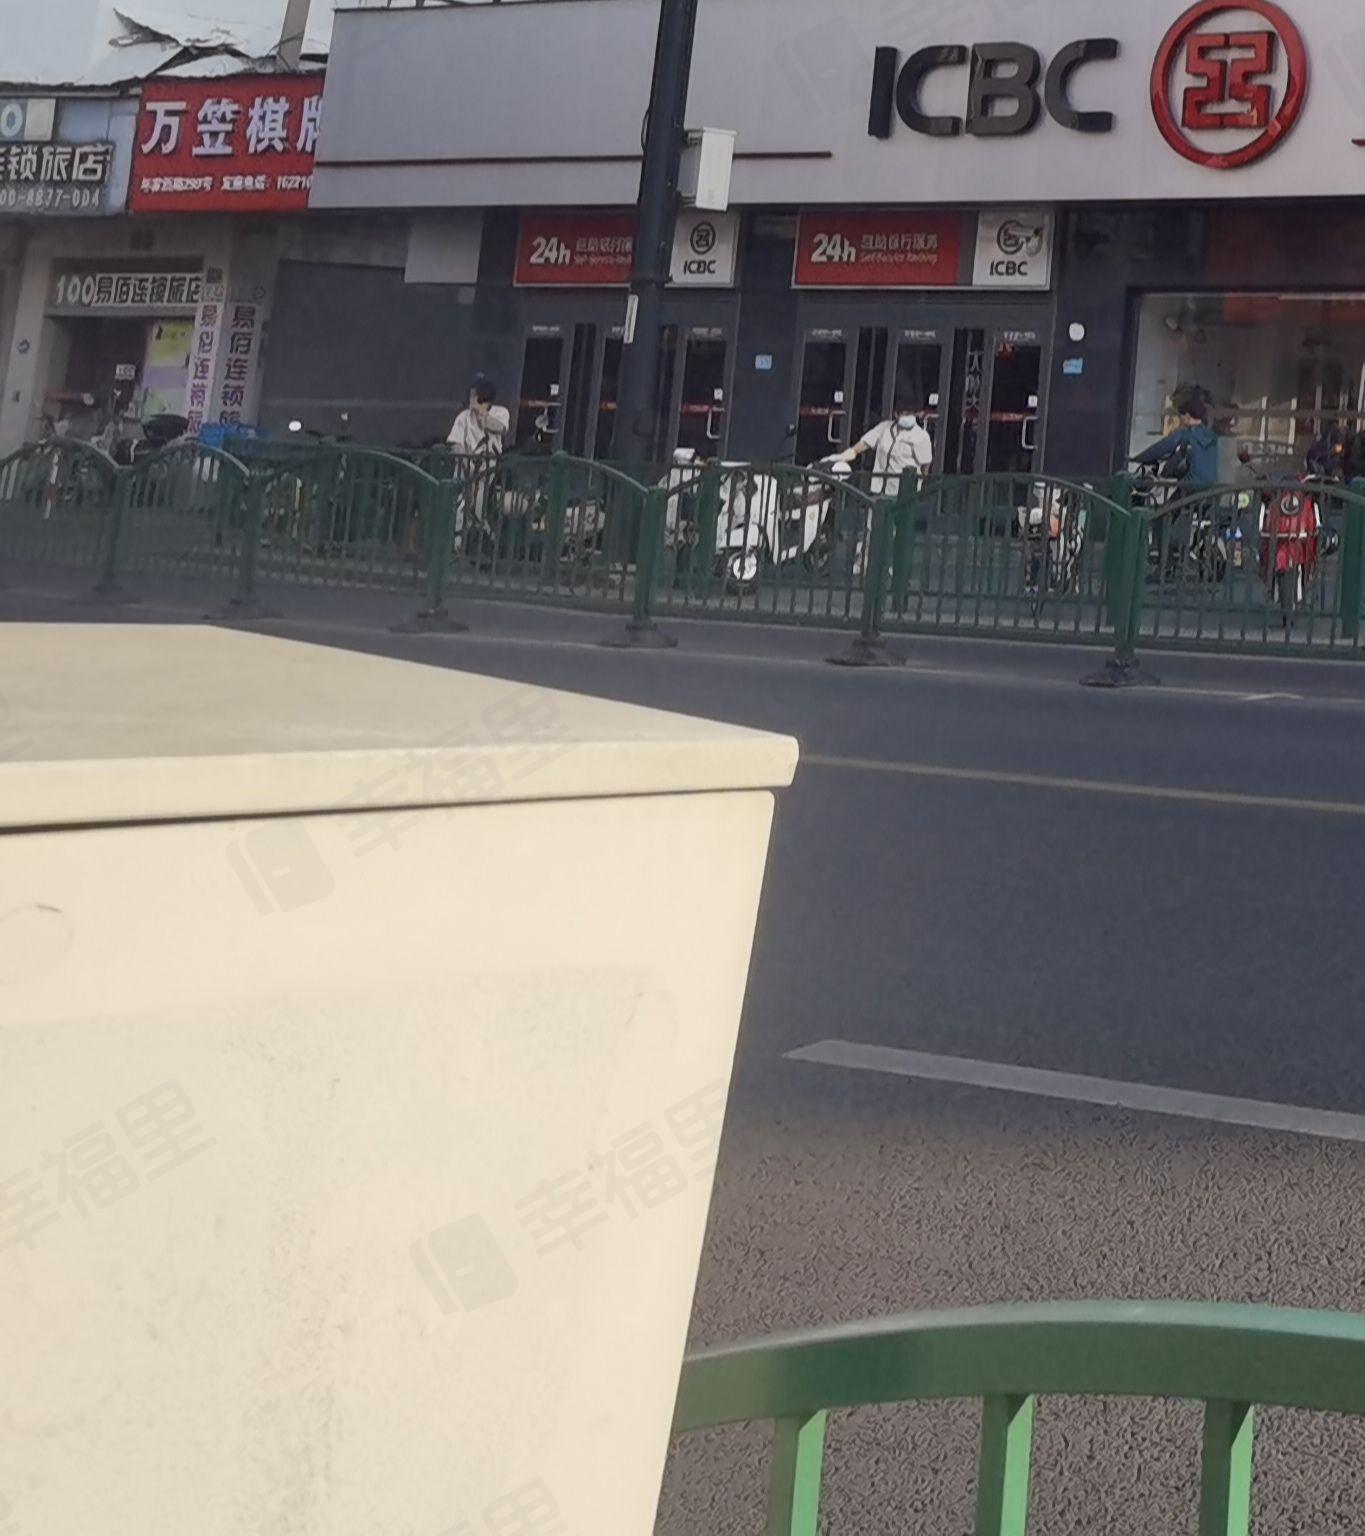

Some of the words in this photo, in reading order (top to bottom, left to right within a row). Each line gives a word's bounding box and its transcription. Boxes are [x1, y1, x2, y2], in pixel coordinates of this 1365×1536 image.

[868, 38, 1120, 139] ICBC
[0, 144, 112, 181] 锁旅店
[530, 237, 571, 265] 24h
[811, 233, 856, 263] 24h
[989, 261, 1028, 276] ICBC
